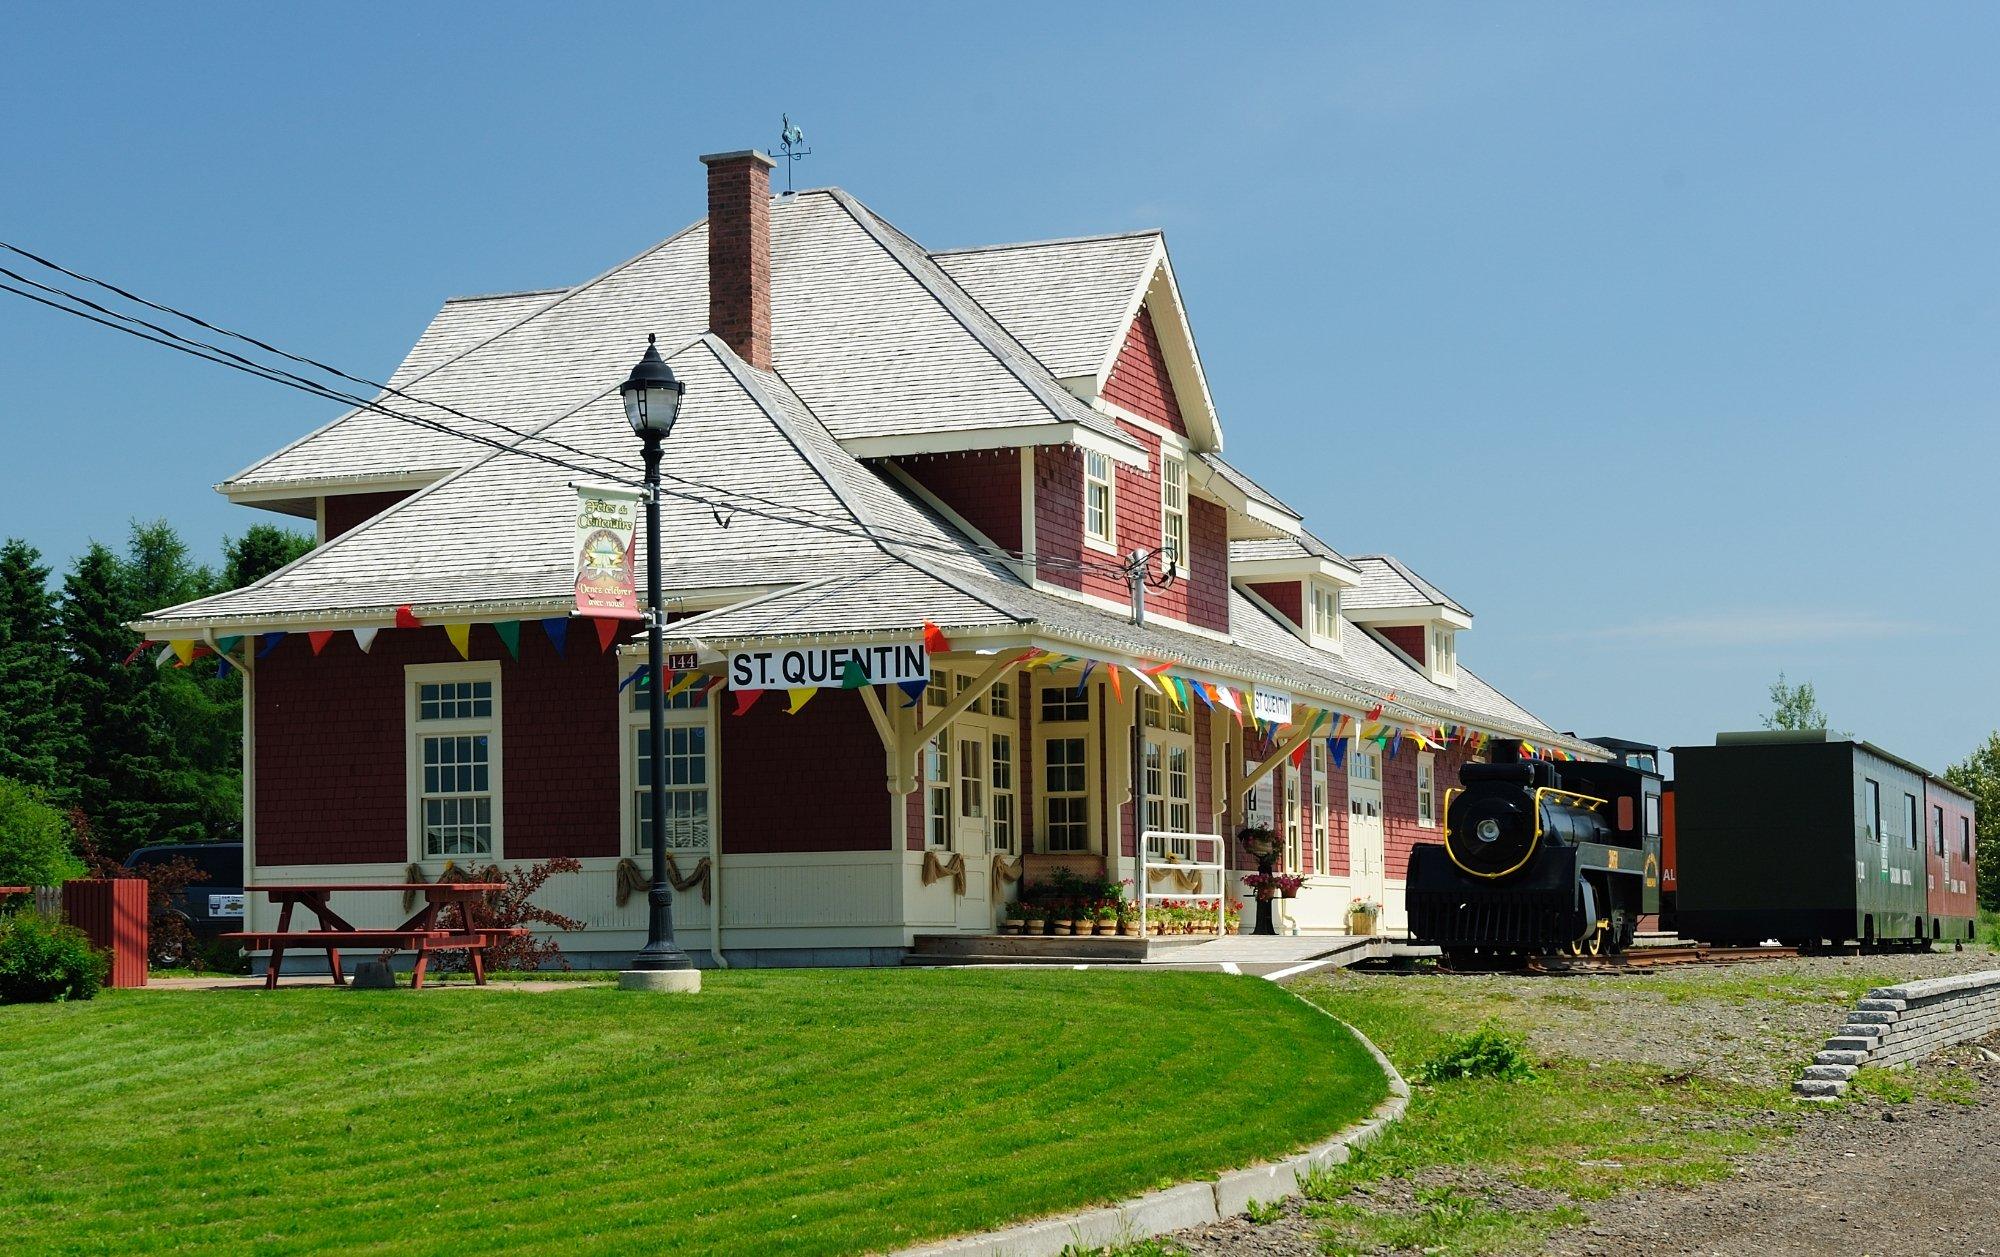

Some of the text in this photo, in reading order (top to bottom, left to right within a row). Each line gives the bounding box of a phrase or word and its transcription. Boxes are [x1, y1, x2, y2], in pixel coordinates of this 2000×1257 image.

[585, 499, 628, 515] Fêtes du
[577, 513, 633, 531] Centenaire
[578, 583, 602, 594] Venez
[670, 655, 695, 669] 144
[733, 644, 925, 686] ST. QUENTIN
[1263, 693, 1288, 716] QUENTIN
